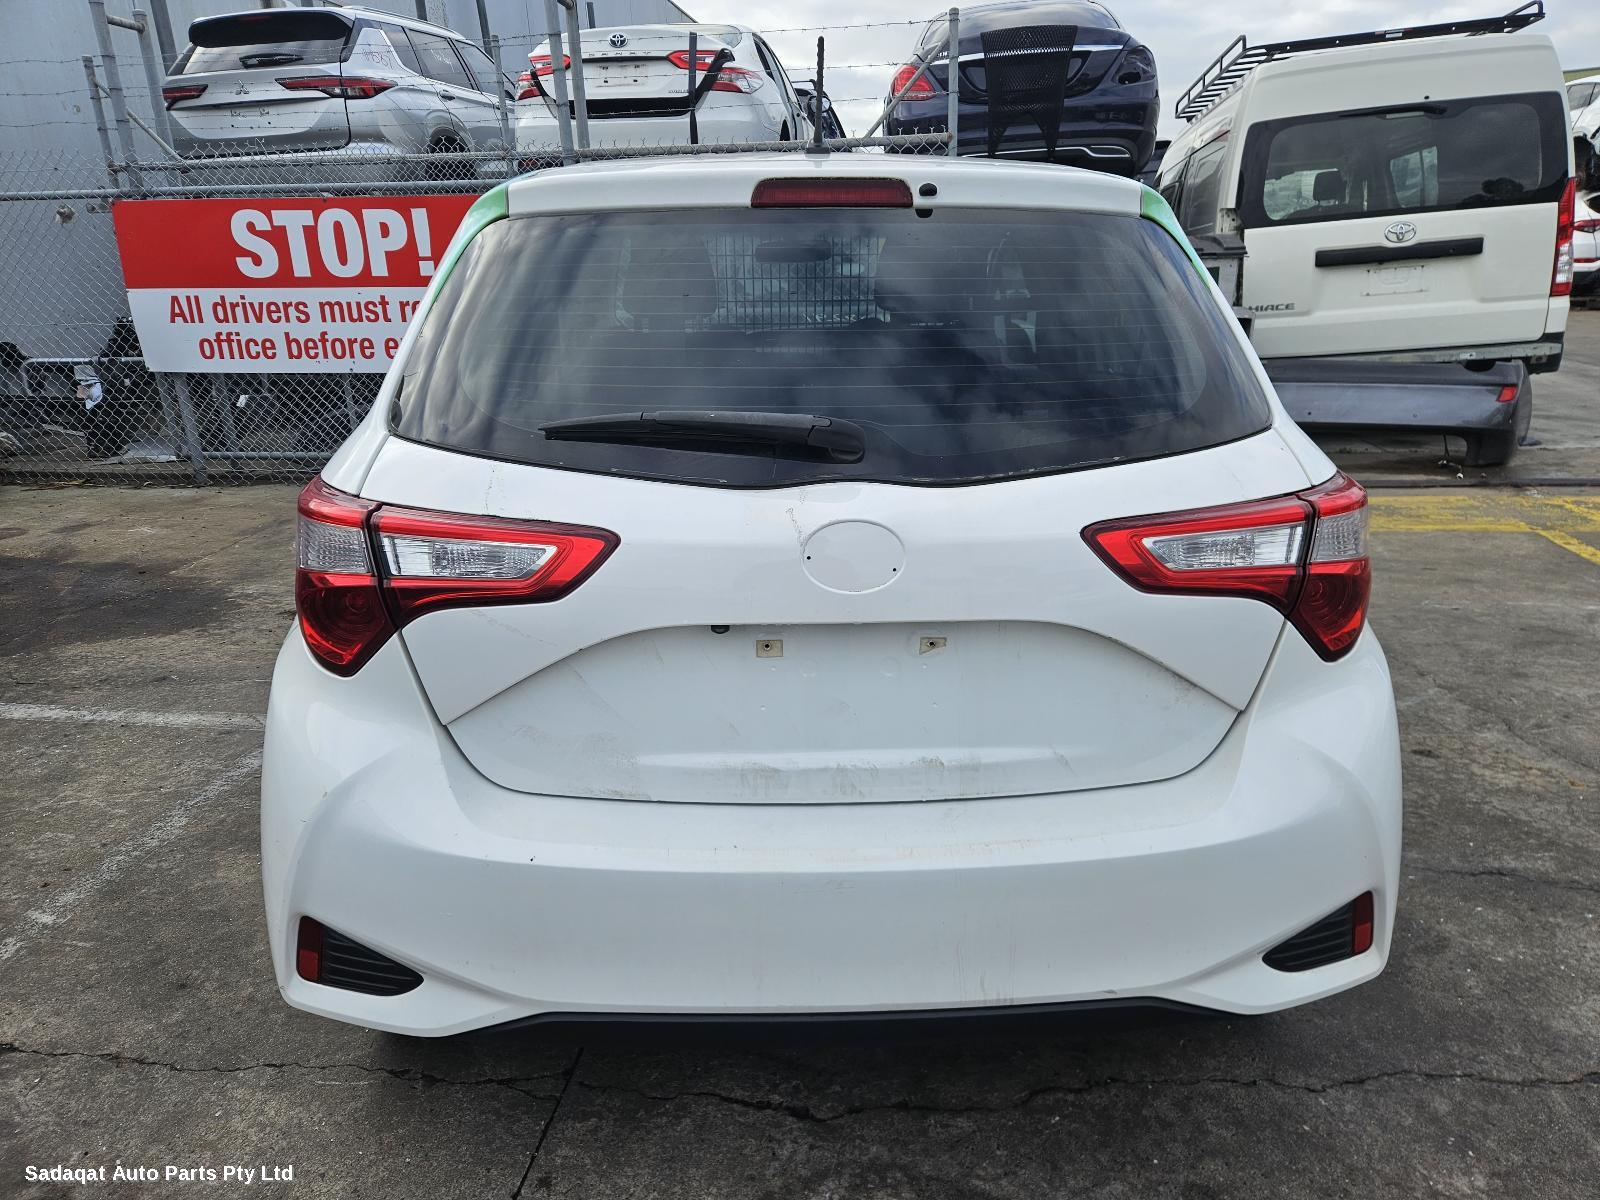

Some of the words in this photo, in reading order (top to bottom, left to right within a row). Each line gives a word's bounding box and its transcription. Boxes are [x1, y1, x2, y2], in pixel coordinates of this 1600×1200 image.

[230, 207, 435, 279] STOP!
[169, 295, 204, 324] All
[211, 295, 311, 324] drivers
[318, 294, 392, 323] must
[1248, 302, 1296, 313] HIACE
[199, 331, 277, 360] office
[284, 331, 376, 360] before
[384, 337, 403, 360] e
